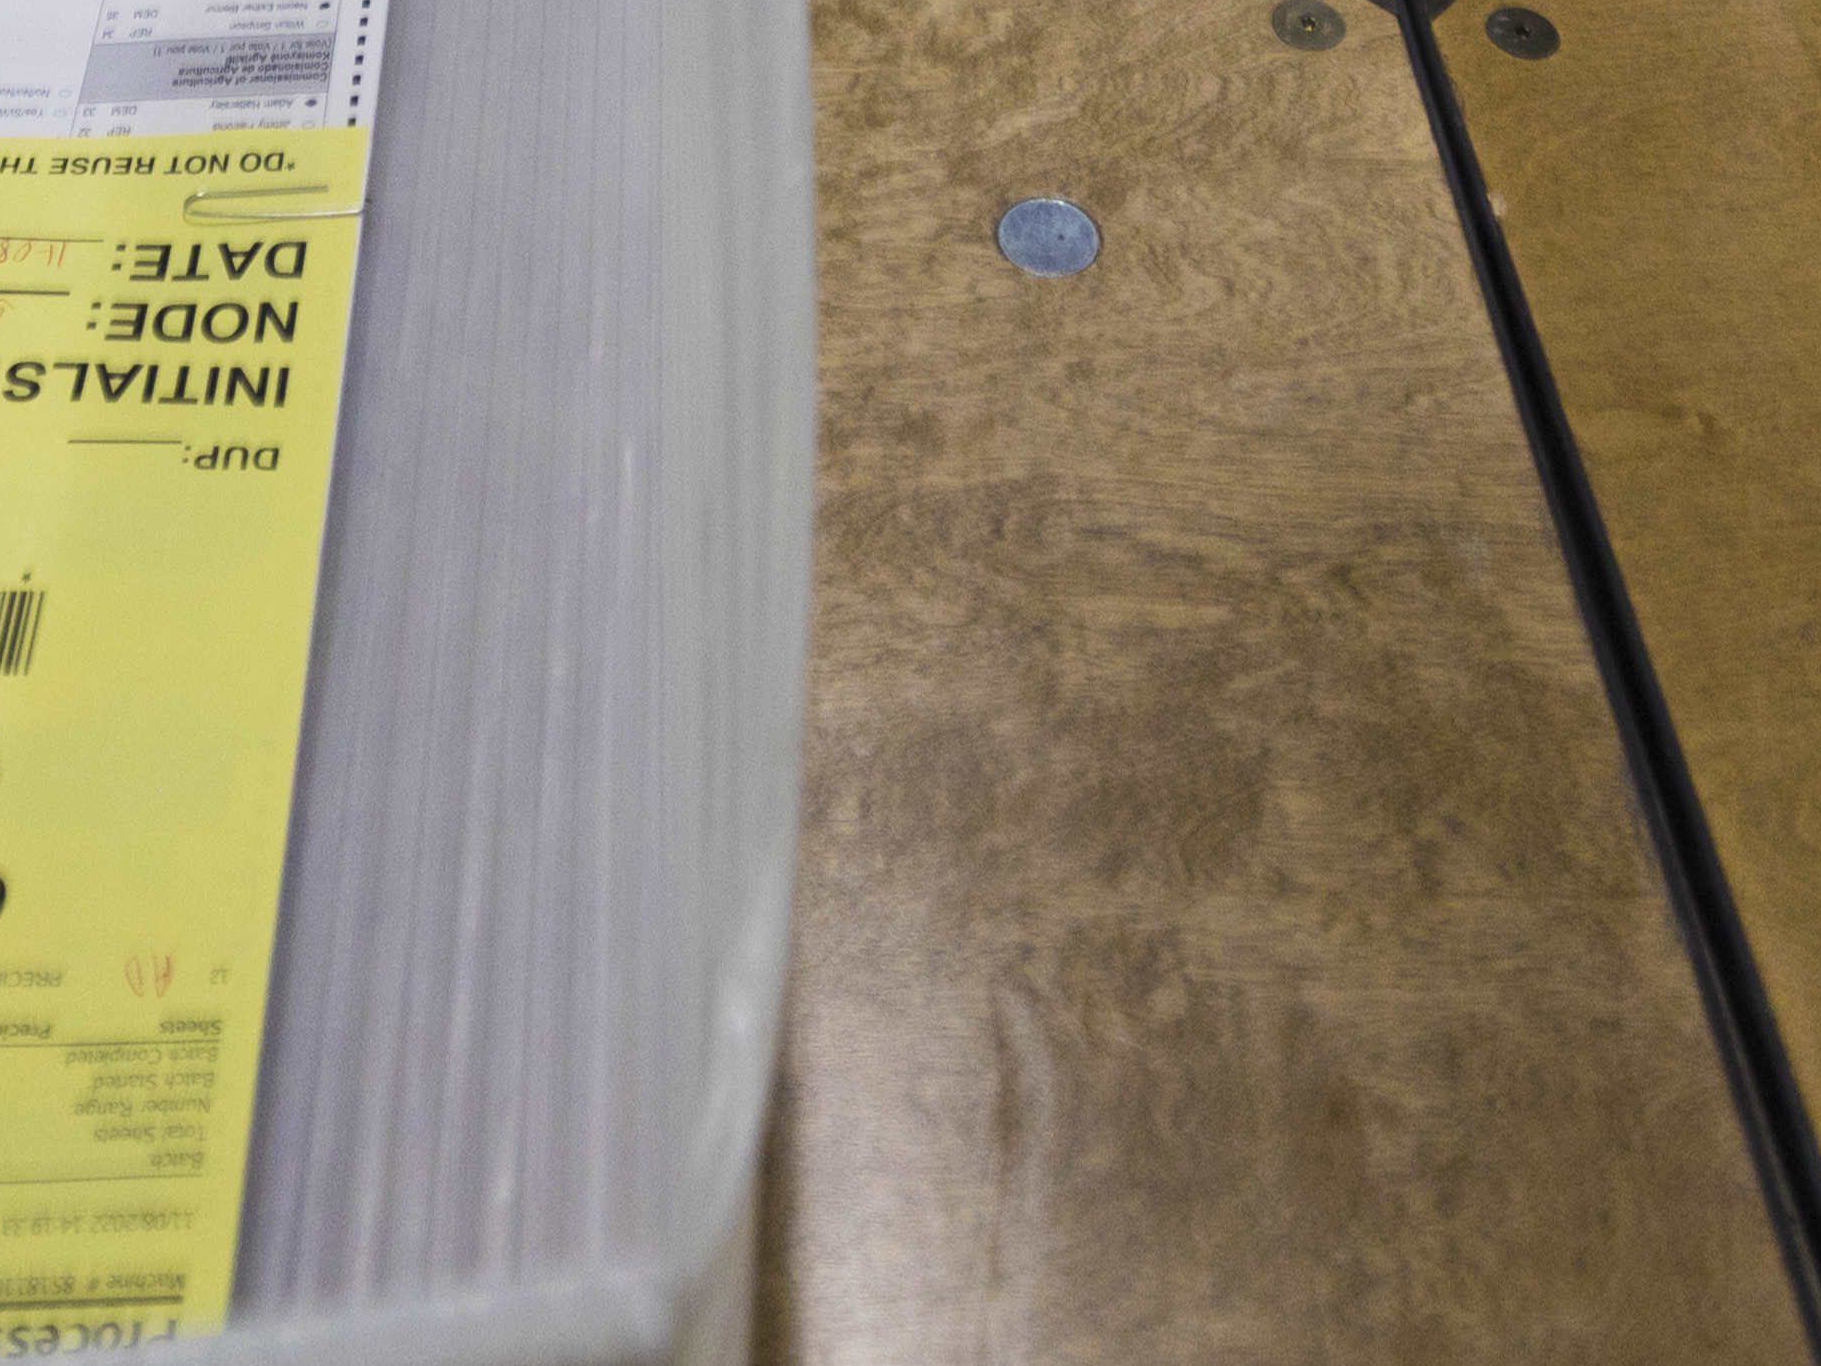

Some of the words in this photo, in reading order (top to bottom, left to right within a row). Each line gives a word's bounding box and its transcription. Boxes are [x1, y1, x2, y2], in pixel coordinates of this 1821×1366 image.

[48, 154, 156, 178] REUSE
[162, 152, 232, 176] NOT
[112, 238, 309, 282] DATE:
[86, 300, 300, 343] NODE:
[182, 443, 280, 473] DUP:
[158, 1018, 223, 1037] Sheets
[73, 1094, 134, 1120] Range
[139, 1097, 211, 1117] Number
[92, 1125, 157, 1146] Sheets
